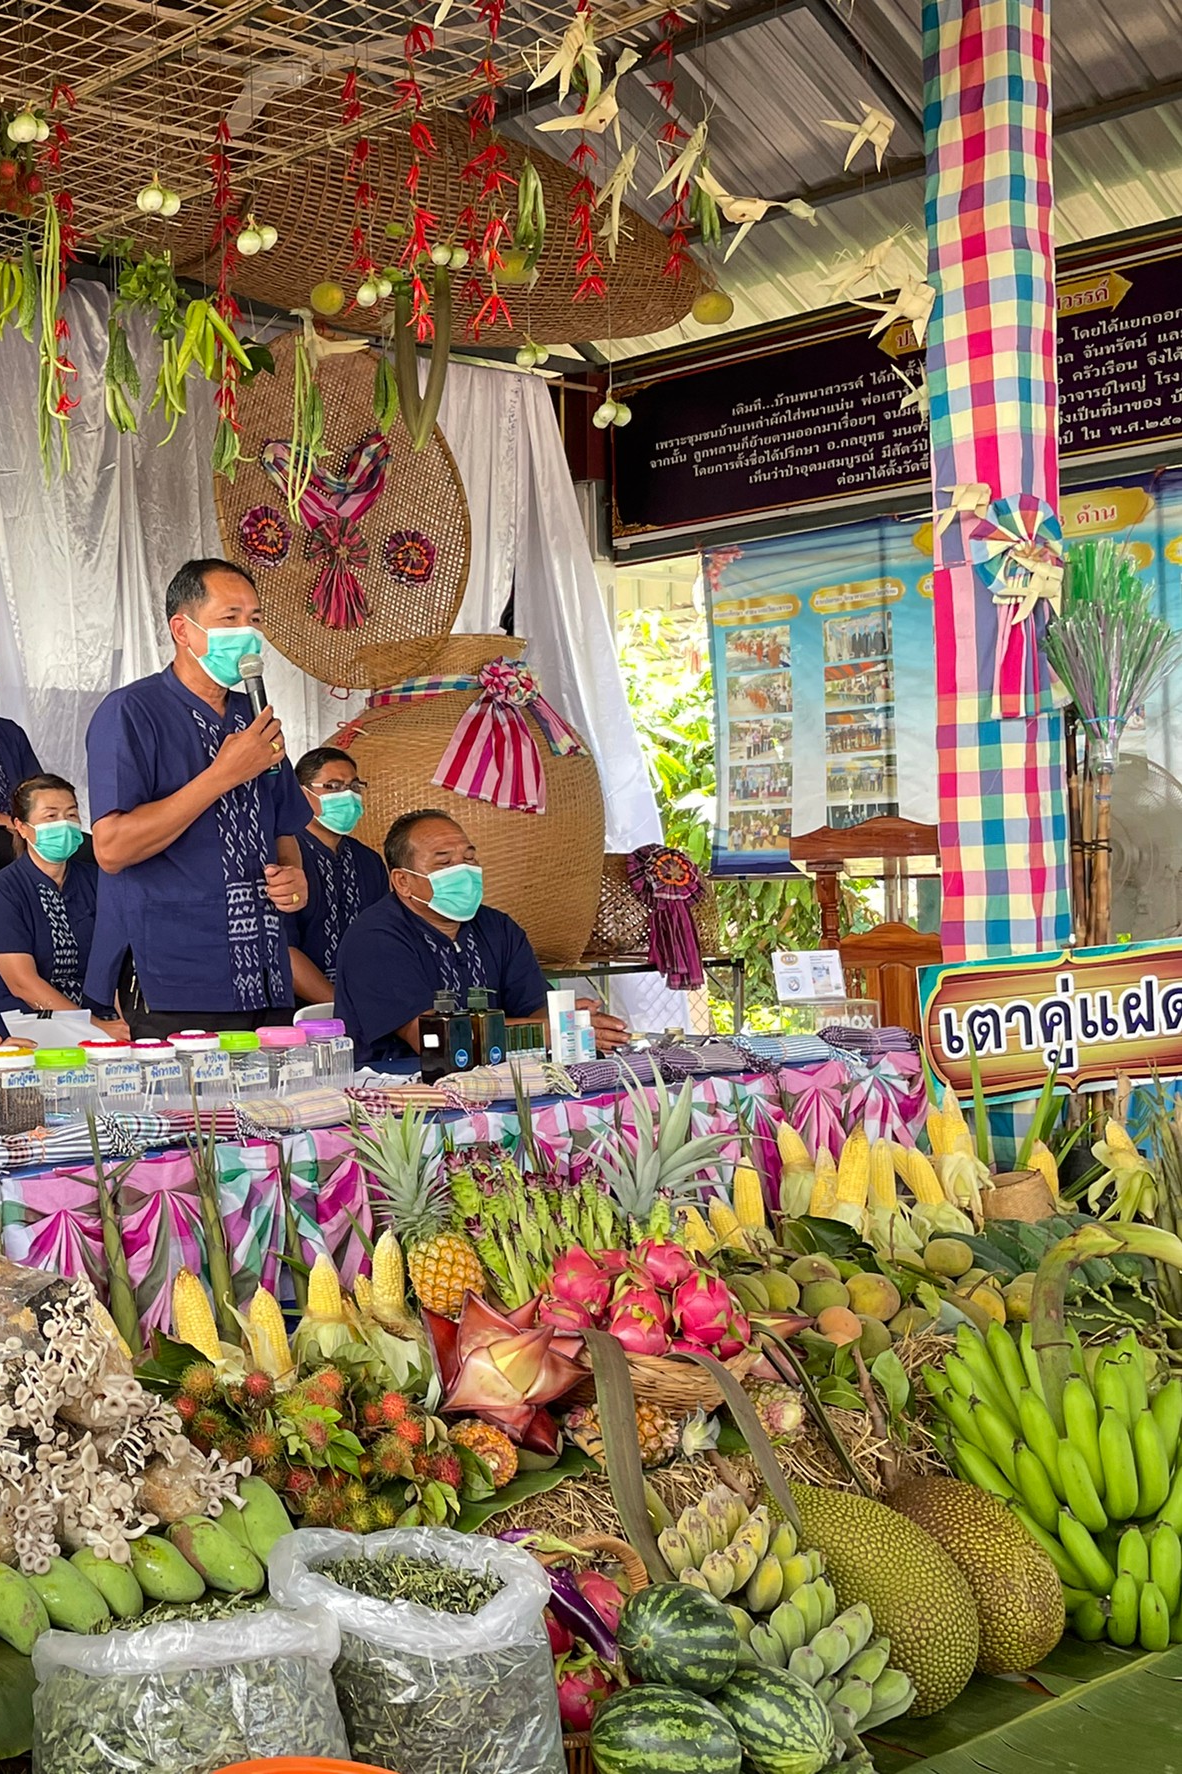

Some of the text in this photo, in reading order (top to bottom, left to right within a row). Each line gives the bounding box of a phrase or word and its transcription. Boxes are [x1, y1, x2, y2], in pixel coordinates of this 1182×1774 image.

[1082, 332, 1147, 359] จันทรัตน์
[650, 448, 687, 468] จากนั้น
[1072, 360, 1138, 382] ครัวเรือน
[1081, 426, 1101, 440] ใน
[1077, 504, 1116, 525] ด้าน
[943, 977, 1182, 1069] เตาคู่แฝด
